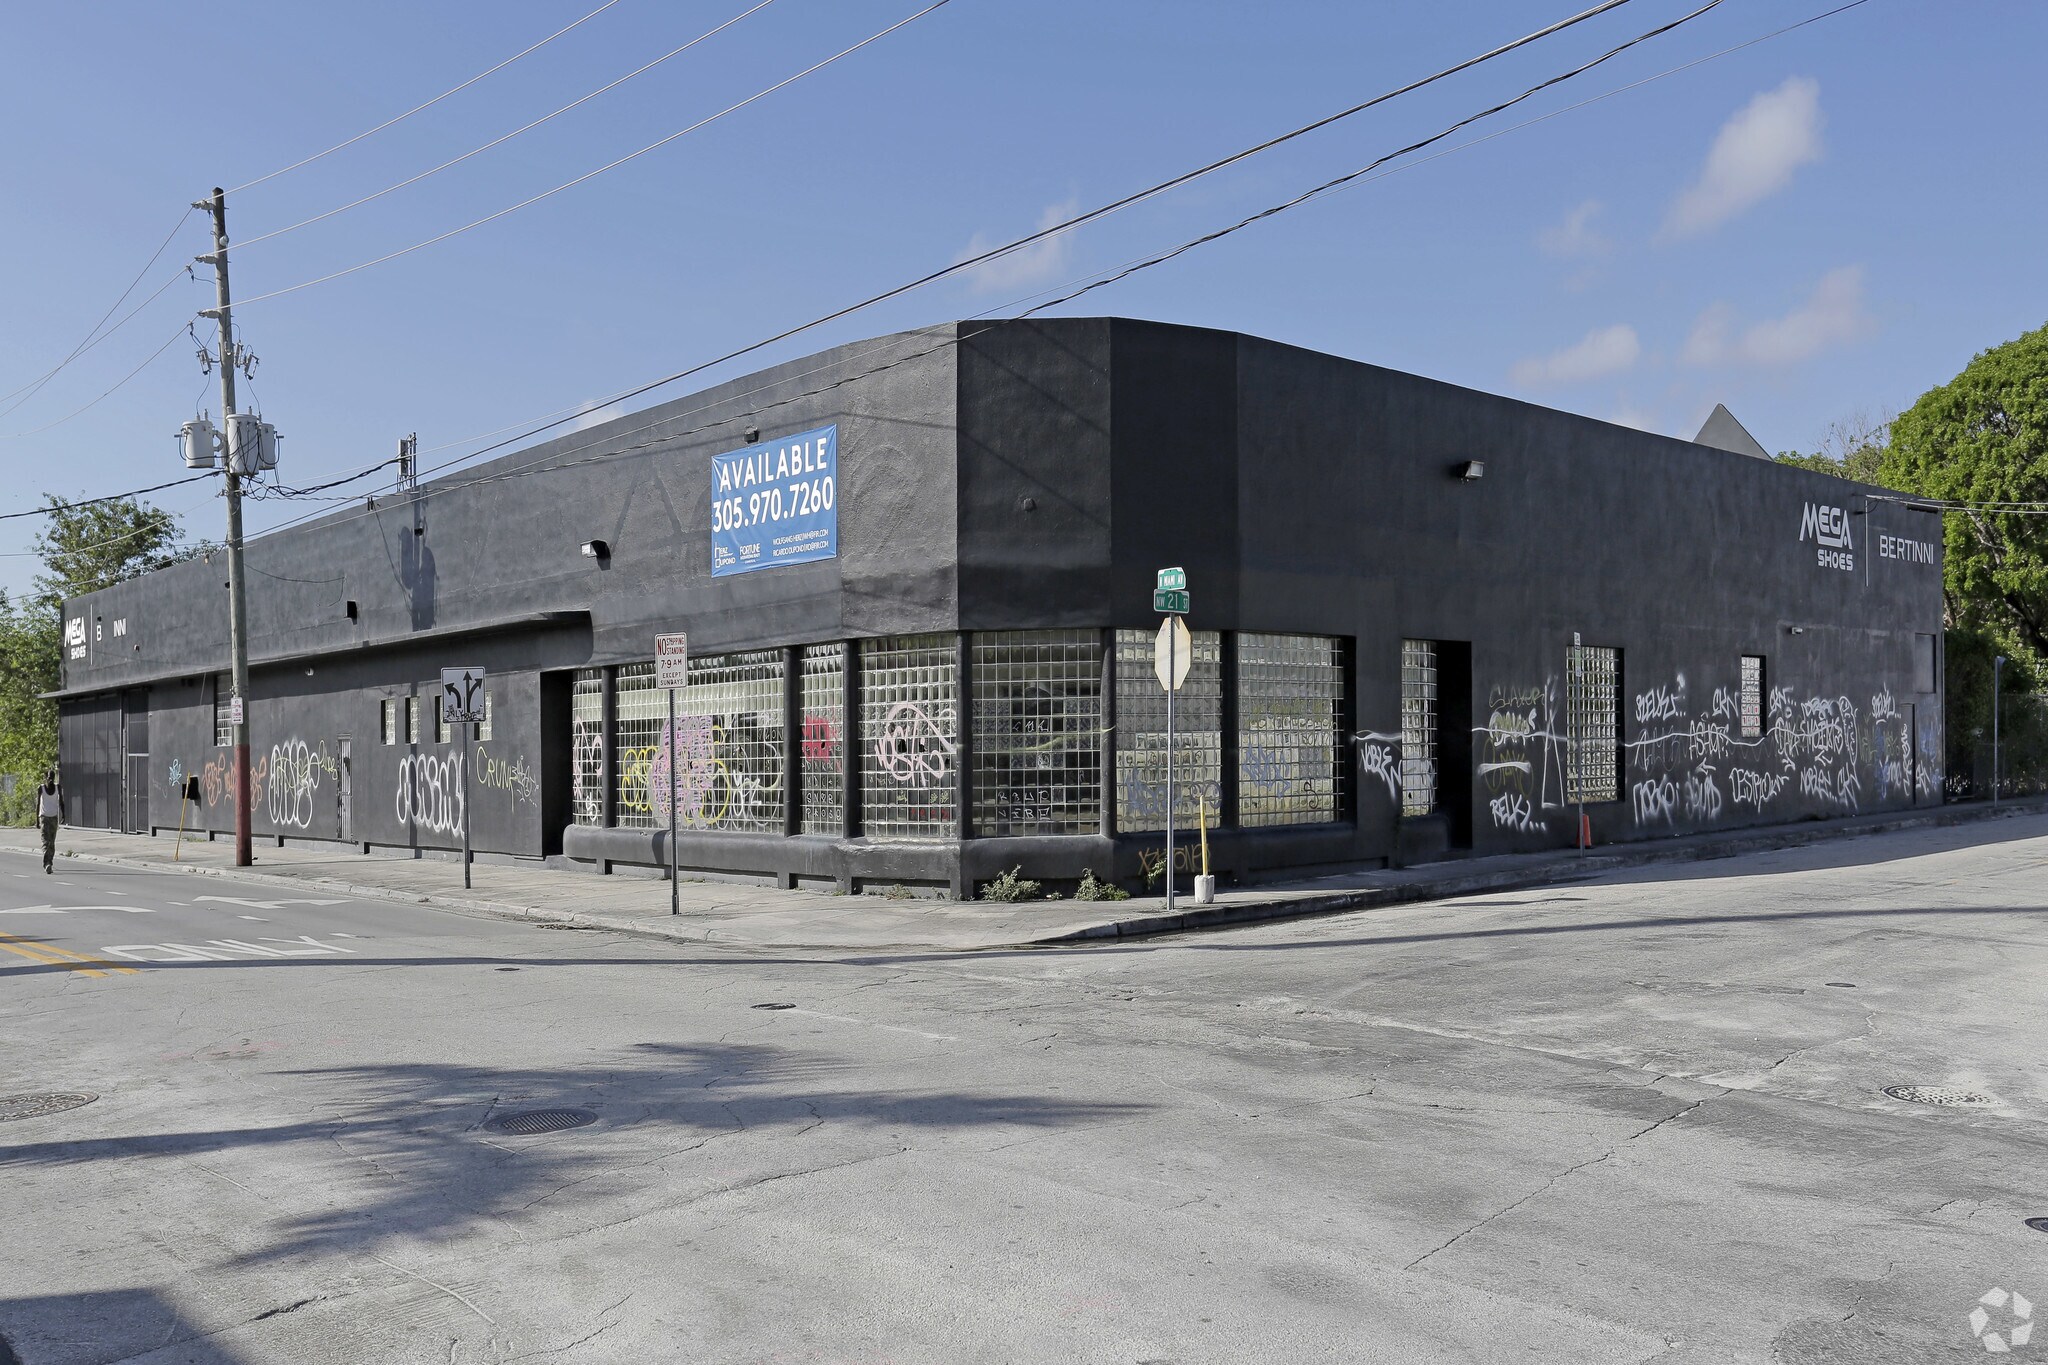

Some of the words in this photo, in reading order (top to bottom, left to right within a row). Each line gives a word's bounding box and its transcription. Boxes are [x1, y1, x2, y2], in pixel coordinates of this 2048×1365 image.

[719, 437, 827, 493] AVAILABLE
[712, 475, 834, 533] 305.970.7260
[1799, 501, 1853, 550] MEGA
[1879, 534, 1934, 565] BERTINNI
[1817, 549, 1854, 571] SHOES
[1156, 596, 1166, 608] NW
[1167, 593, 1178, 609] 21
[64, 616, 86, 648] MEGA
[657, 638, 667, 656] NO
[666, 637, 685, 646] STOPPING
[70, 645, 87, 660] SHOES
[666, 646, 685, 656] STANDING
[660, 678, 684, 686] SUNDAYS
[662, 671, 682, 679] EXCEPT
